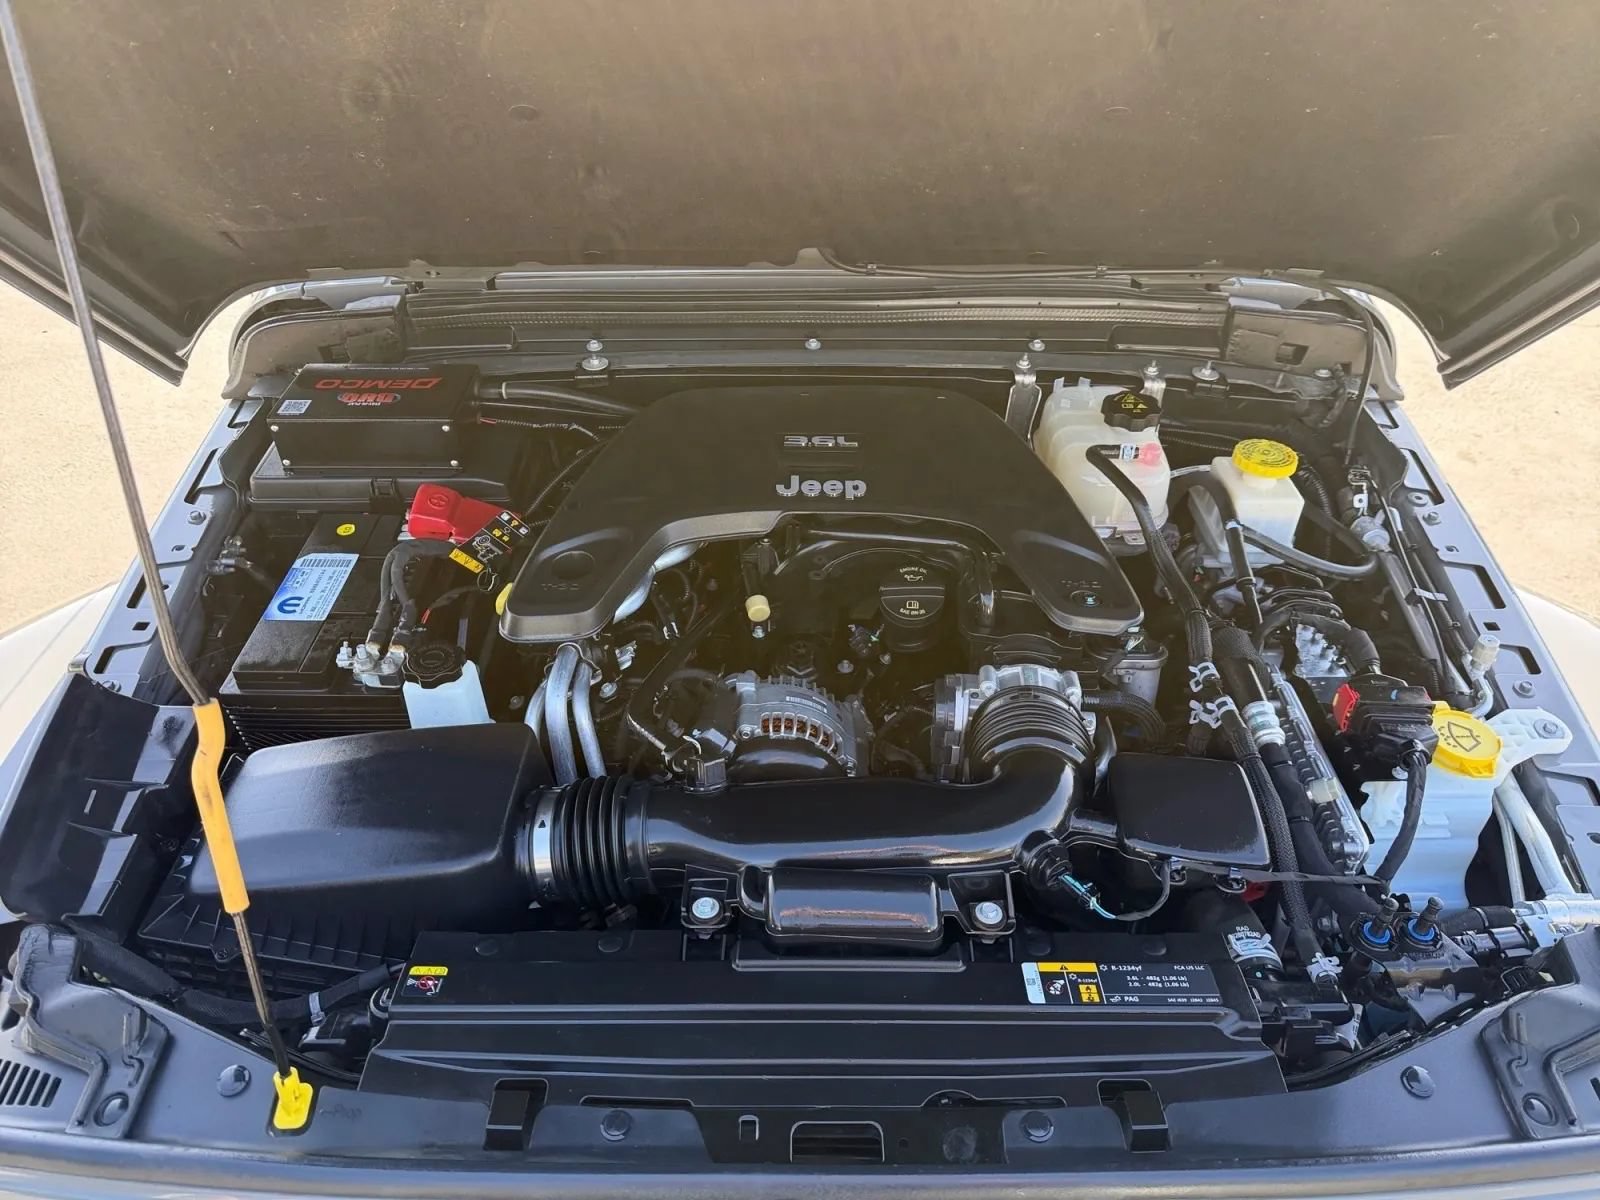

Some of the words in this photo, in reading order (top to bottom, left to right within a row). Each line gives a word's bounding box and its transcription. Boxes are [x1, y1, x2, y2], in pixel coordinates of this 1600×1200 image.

[315, 377, 443, 389] DEMCO
[783, 435, 859, 447] 3.6L
[775, 474, 867, 501] Jeep
